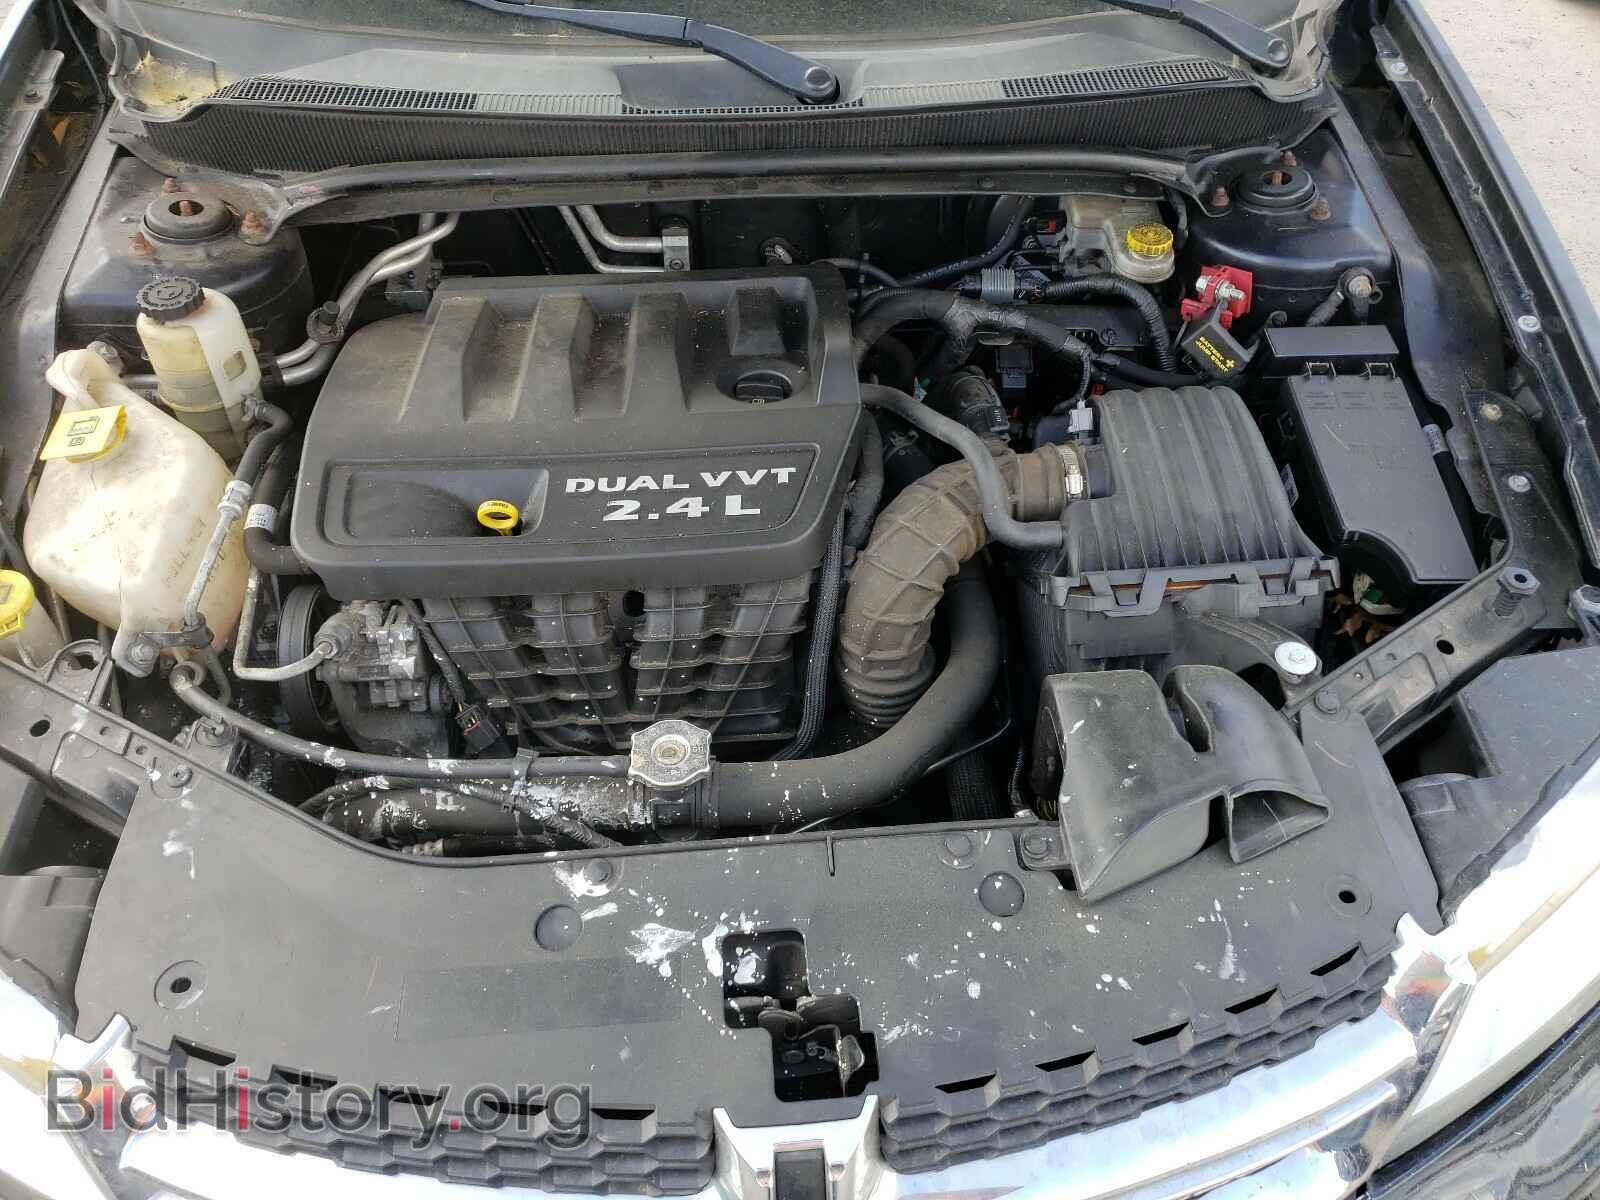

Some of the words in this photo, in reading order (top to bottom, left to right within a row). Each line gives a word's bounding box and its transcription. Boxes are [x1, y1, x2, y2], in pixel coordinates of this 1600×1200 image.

[1195, 340, 1212, 356] JUMP
[1210, 354, 1229, 374] START
[1199, 336, 1225, 361] BATTERY
[565, 474, 690, 494] DUAL
[700, 467, 797, 488] VVT
